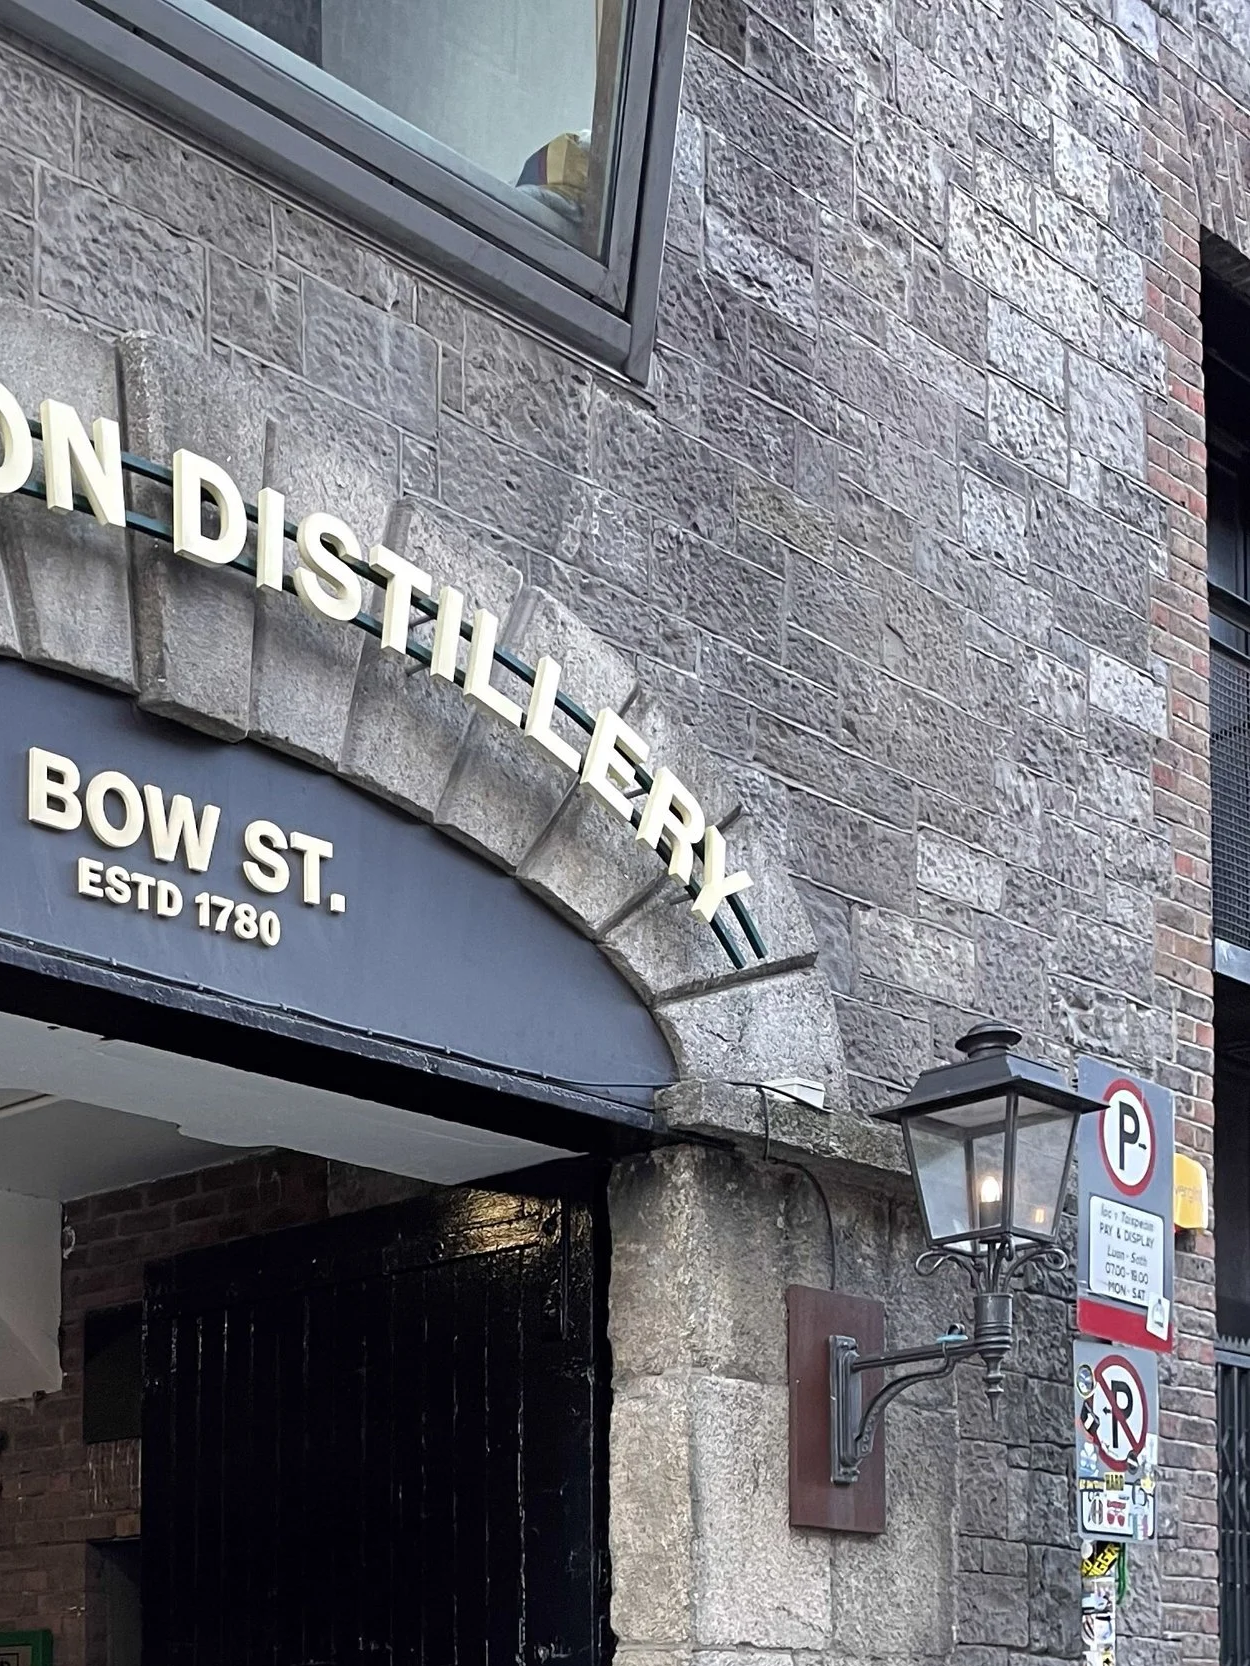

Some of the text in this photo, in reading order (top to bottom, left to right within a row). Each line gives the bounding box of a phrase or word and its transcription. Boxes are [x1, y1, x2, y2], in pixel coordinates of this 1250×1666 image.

[172, 448, 754, 925] DISTILLERY
[28, 746, 347, 914] BOW ST.
[77, 856, 282, 948] ESTD 1780
[1118, 1100, 1141, 1171] P
[1099, 1221, 1113, 1236] PAY
[1124, 1230, 1155, 1249] DISPLAY
